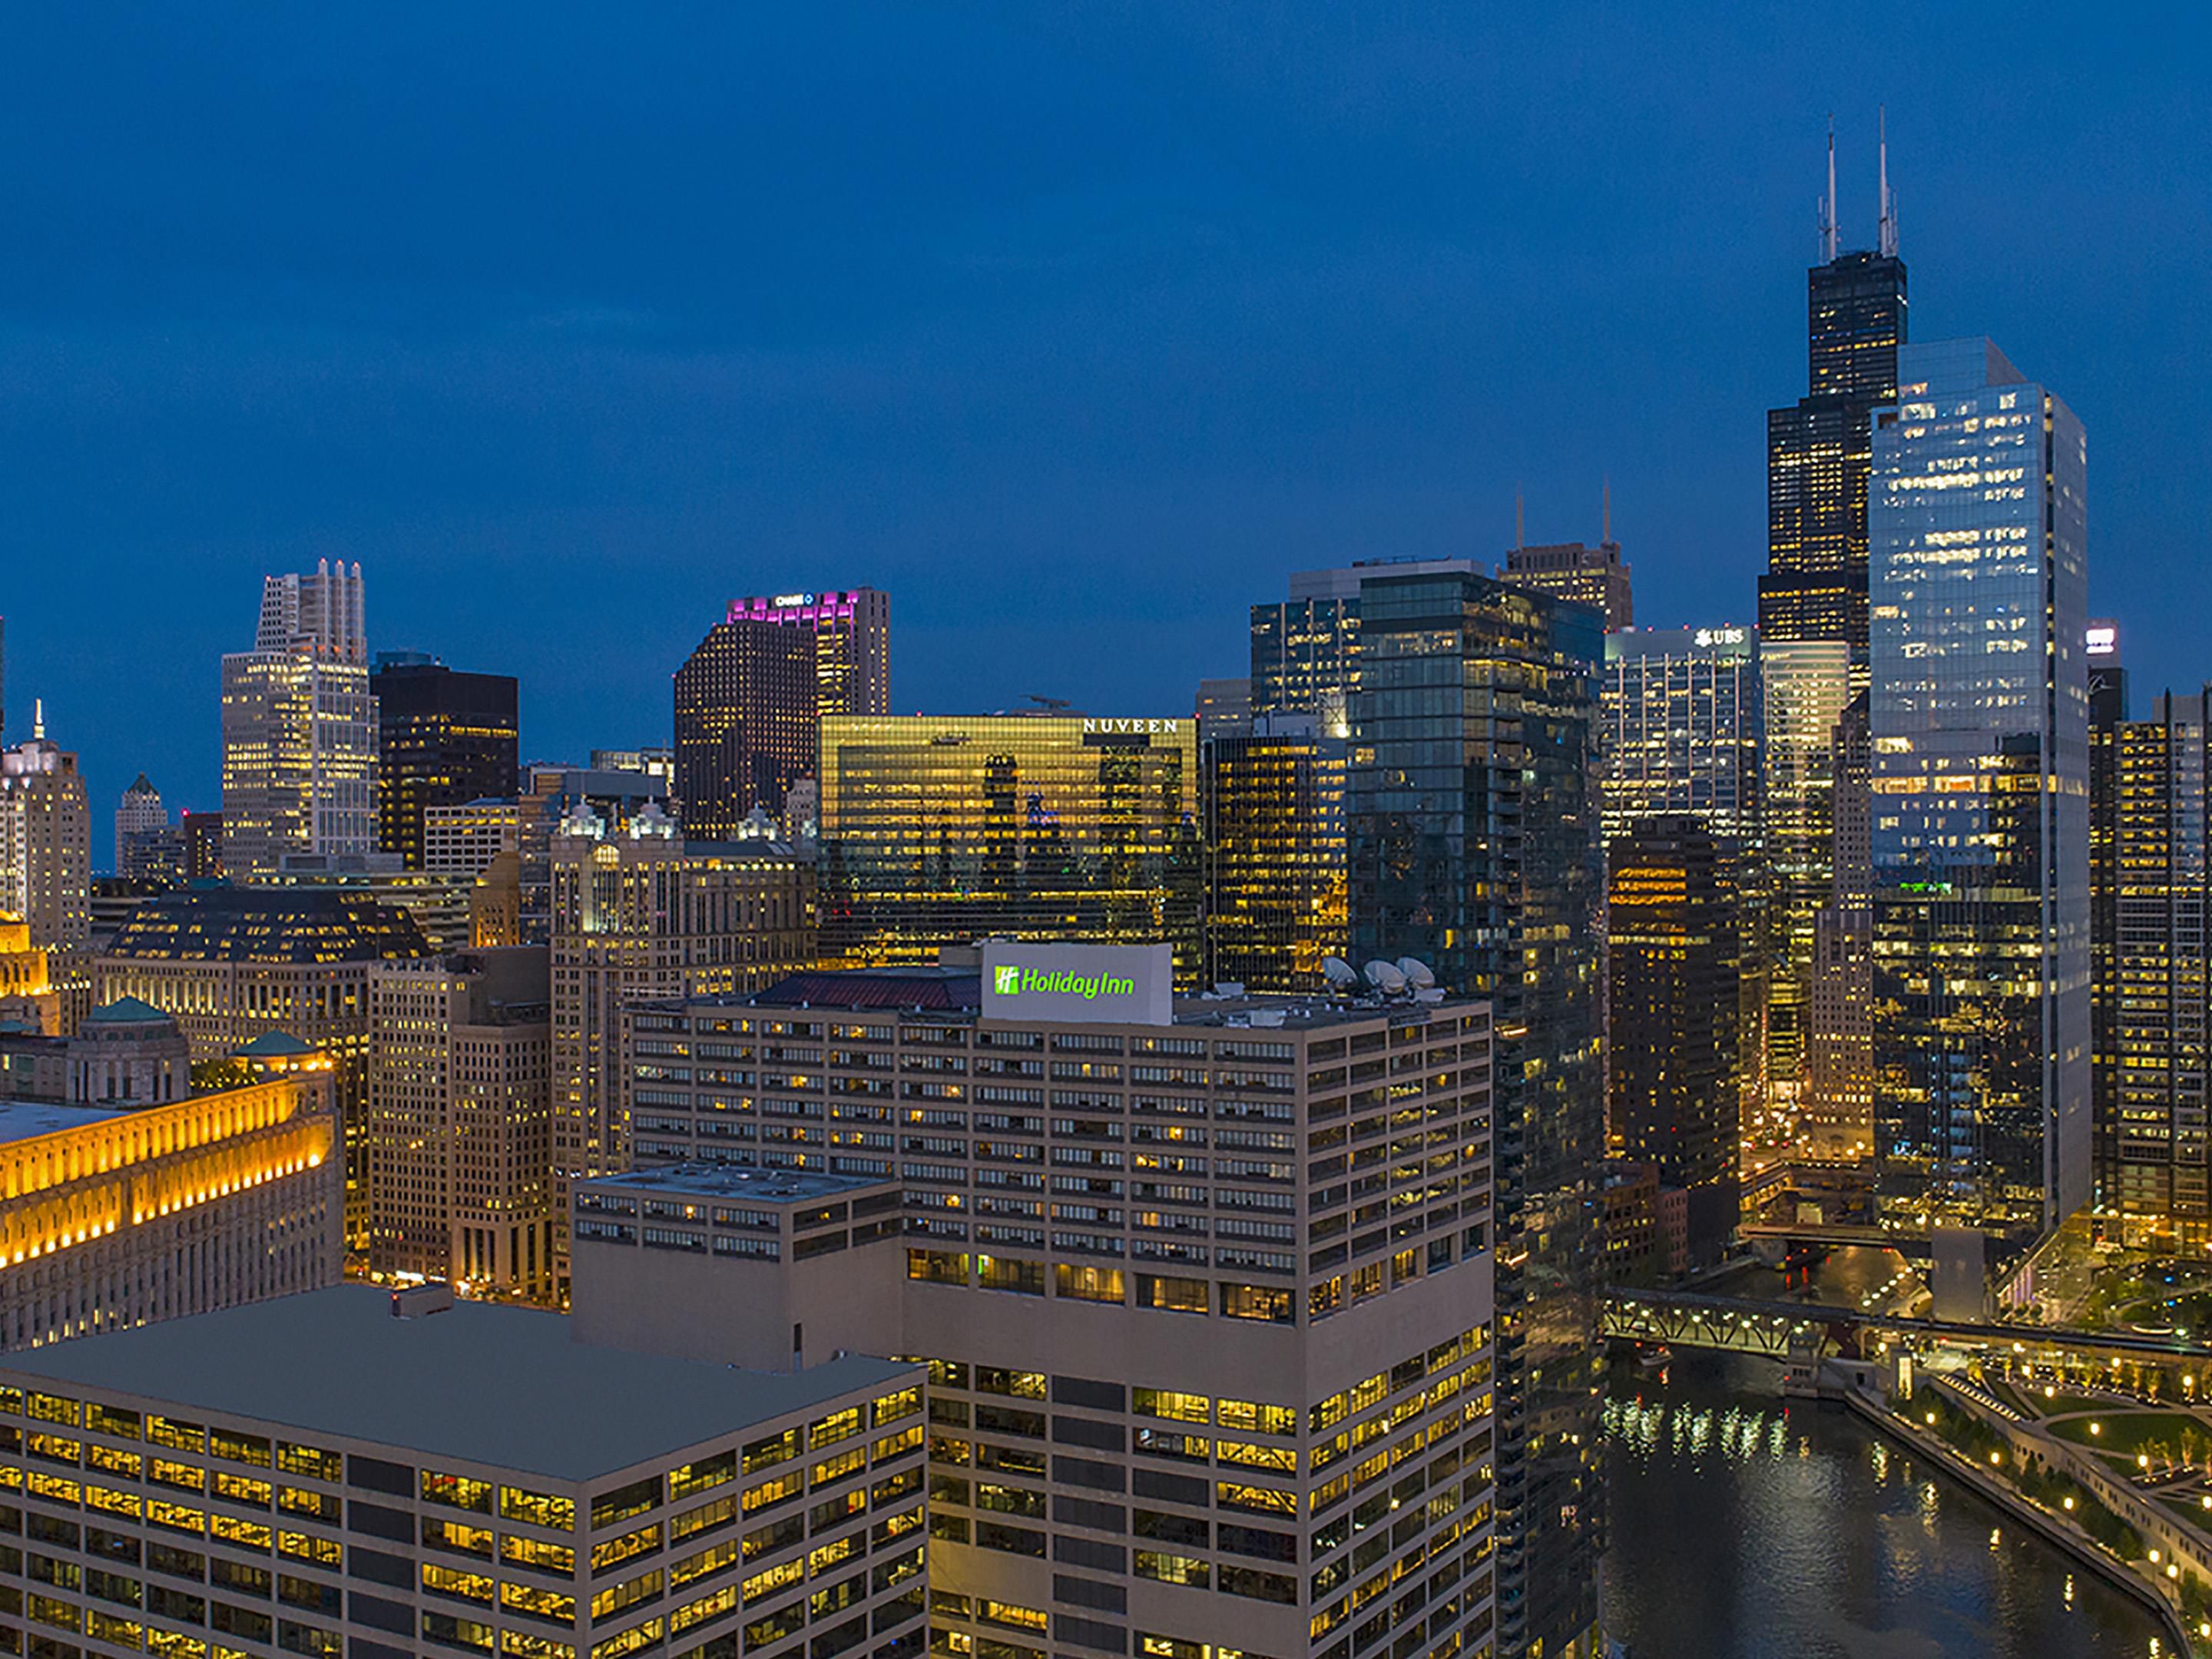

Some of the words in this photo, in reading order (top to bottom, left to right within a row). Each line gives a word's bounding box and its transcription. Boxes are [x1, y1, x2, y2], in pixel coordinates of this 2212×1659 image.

[1714, 629, 1744, 645] UBS
[1083, 718, 1177, 733] NUVEEN
[1021, 968, 1099, 1000] Holiday
[1100, 972, 1134, 995] Inn
